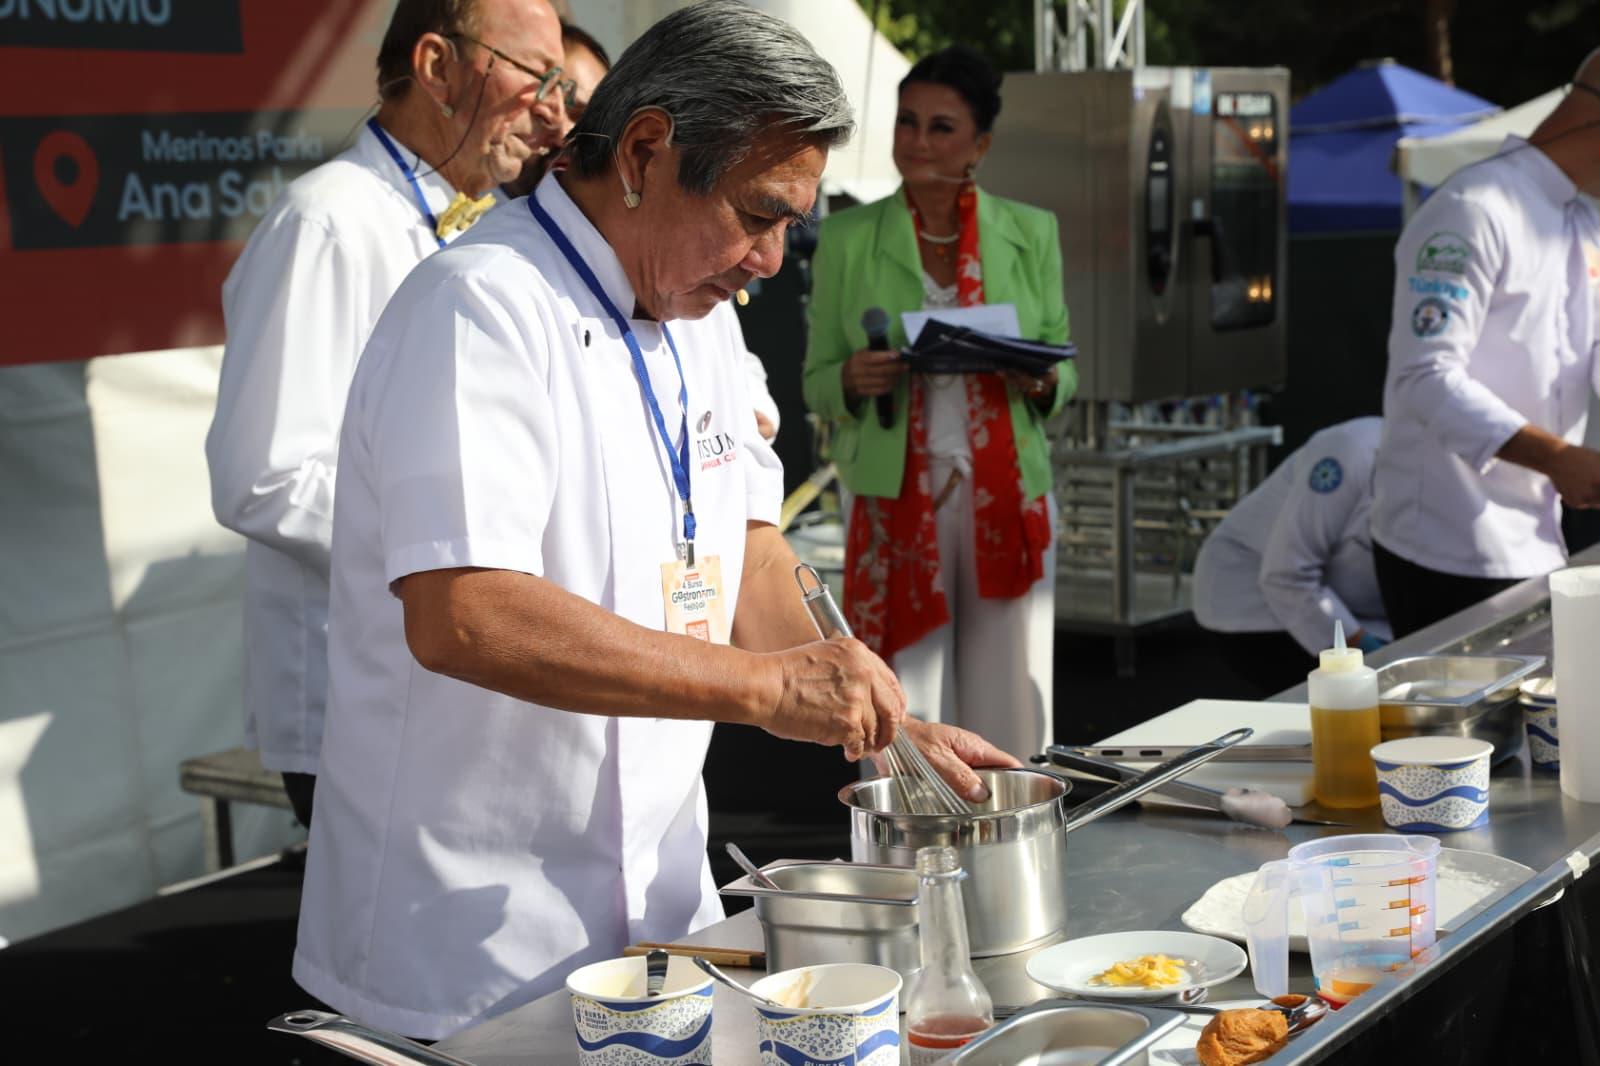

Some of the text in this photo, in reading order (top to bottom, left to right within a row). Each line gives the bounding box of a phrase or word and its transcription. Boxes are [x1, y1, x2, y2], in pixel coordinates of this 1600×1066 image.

[0, 0, 173, 26] NUMU
[141, 129, 251, 161] Merinos
[117, 171, 212, 221] Ana
[584, 1009, 607, 1020] BURSA
